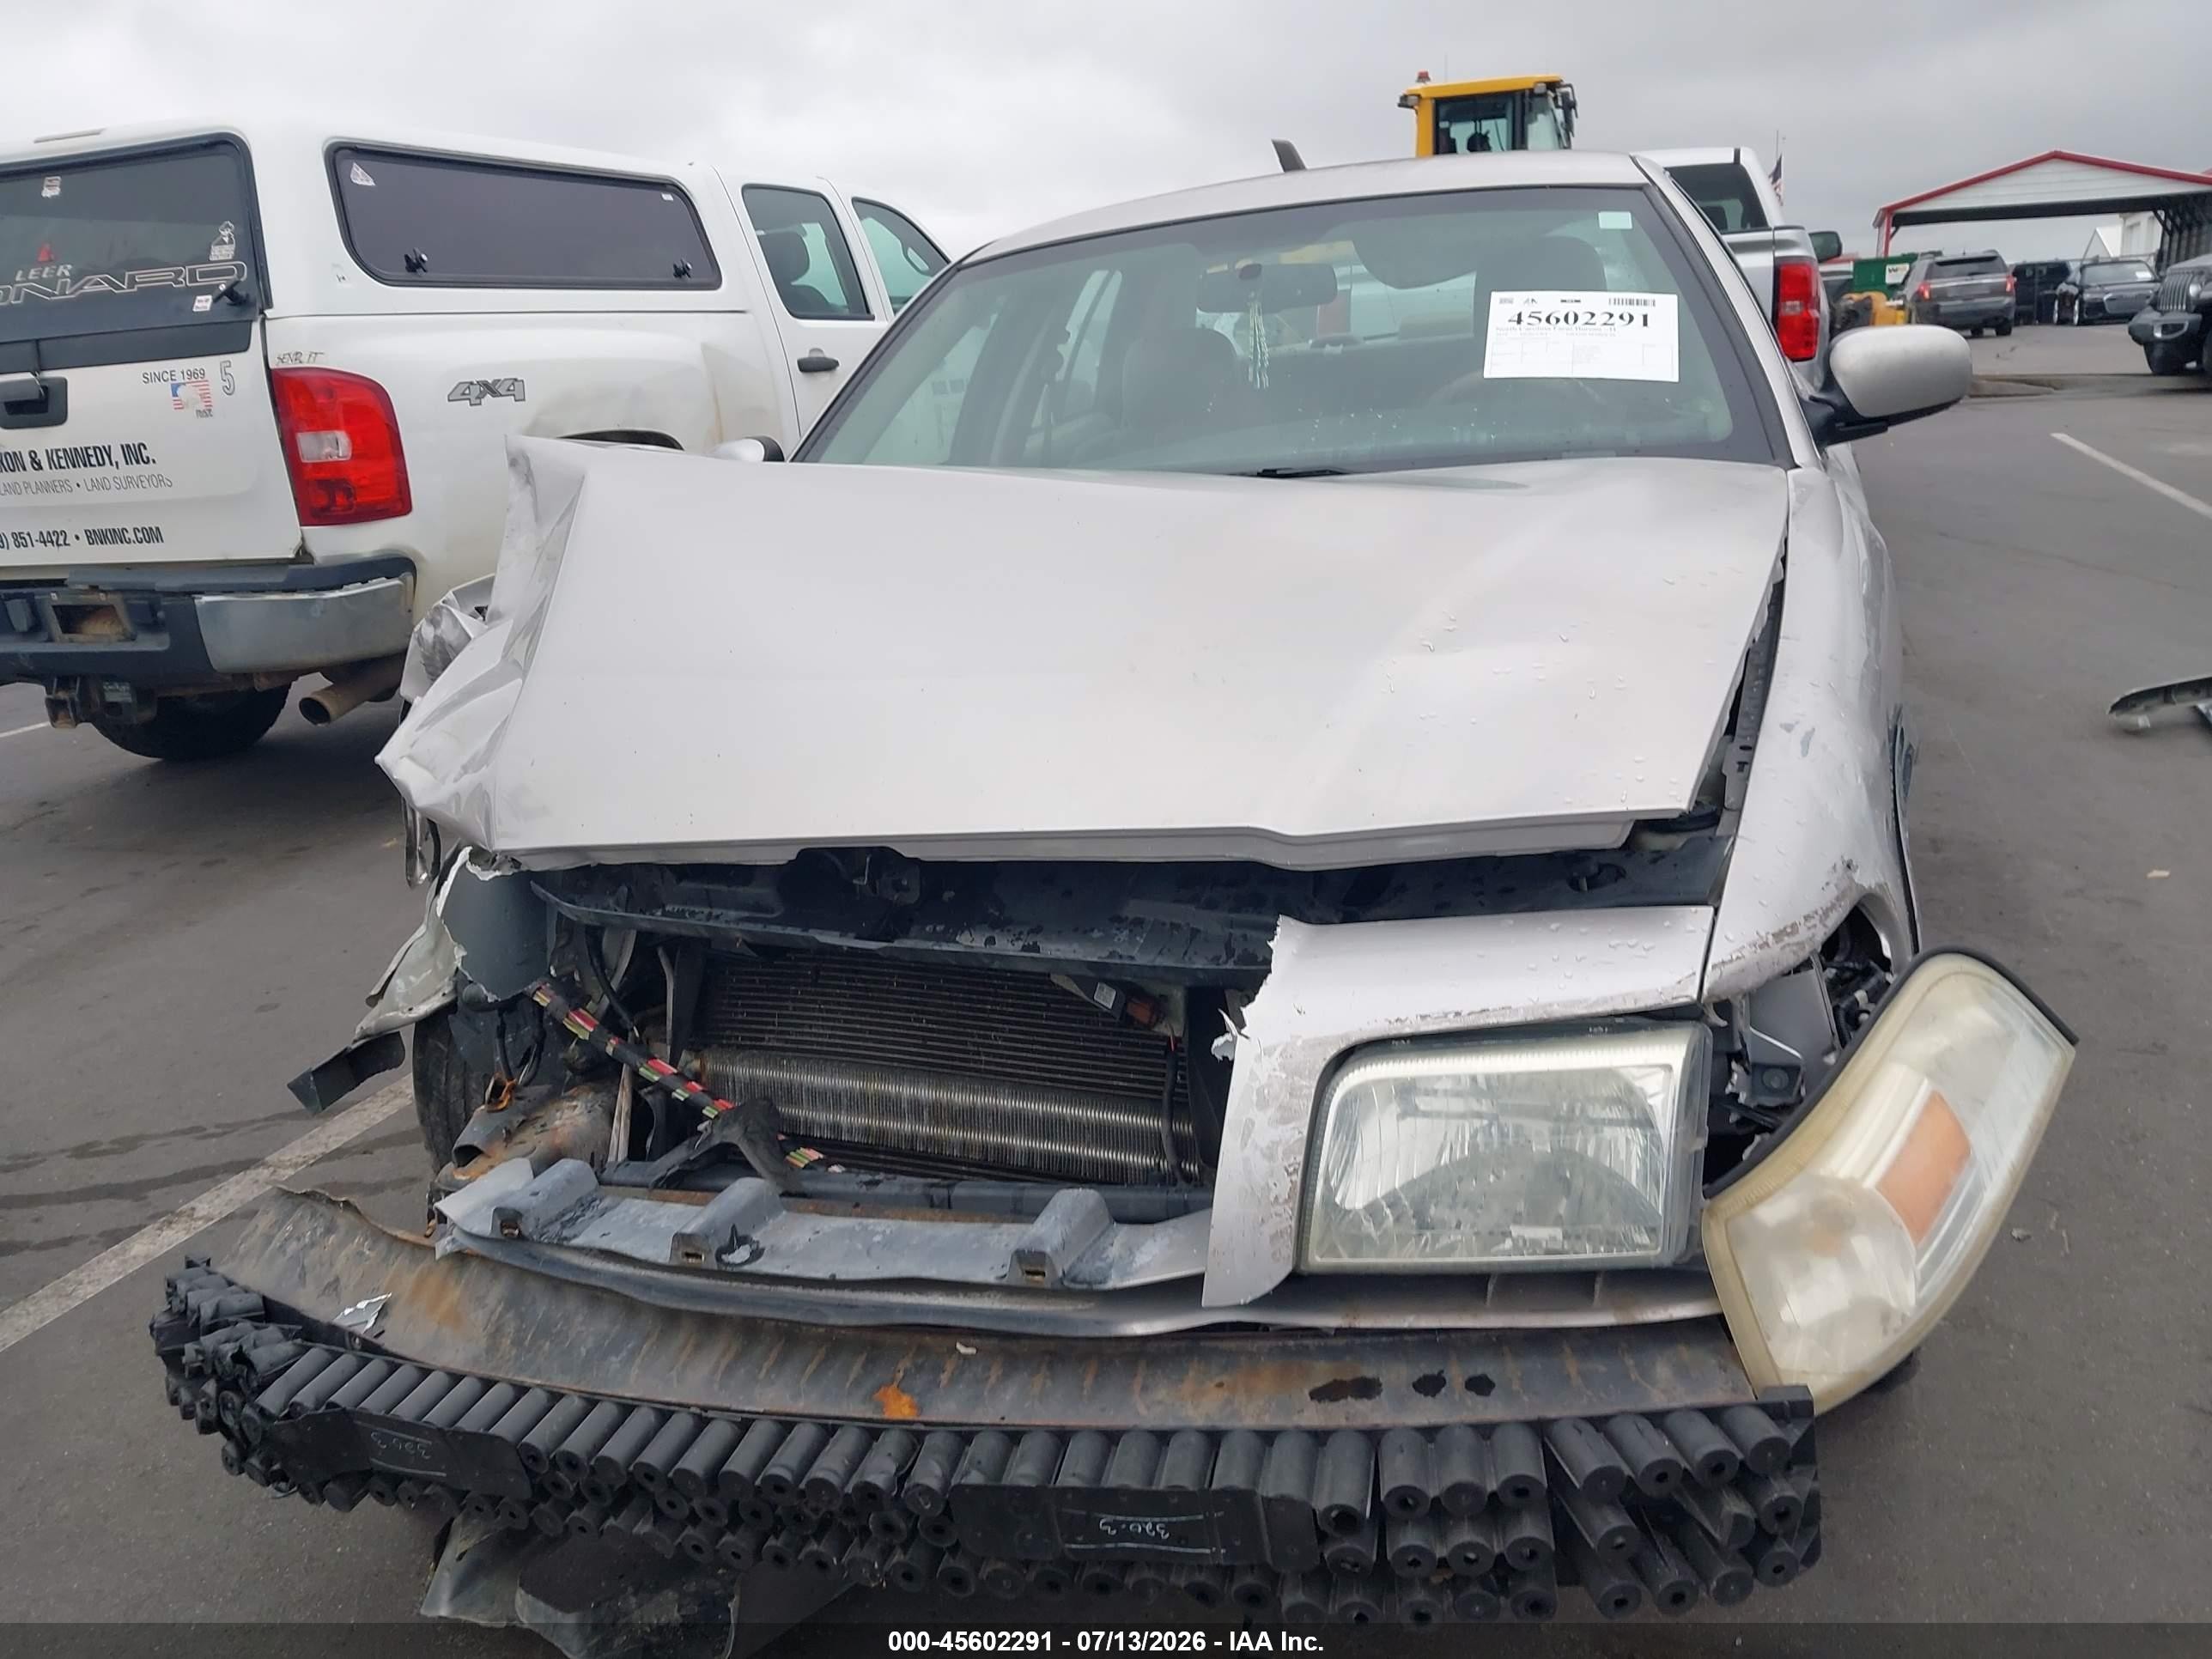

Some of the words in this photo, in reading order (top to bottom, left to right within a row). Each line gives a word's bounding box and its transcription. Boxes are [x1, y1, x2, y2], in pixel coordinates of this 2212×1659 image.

[15, 264, 73, 282] LEER
[1507, 310, 1650, 328] 45602291
[142, 369, 177, 385] SINCE
[179, 368, 206, 381] 1969
[219, 360, 236, 396] 5
[27, 449, 44, 471] &
[45, 444, 120, 471] KENNEDY,
[120, 442, 157, 466] INC.
[22, 479, 74, 495] PLANNERS
[83, 477, 112, 492] LAND
[112, 474, 173, 491] SURVEYORS
[11, 529, 70, 549] 851-4422
[84, 526, 165, 546] BNKINC.COM
